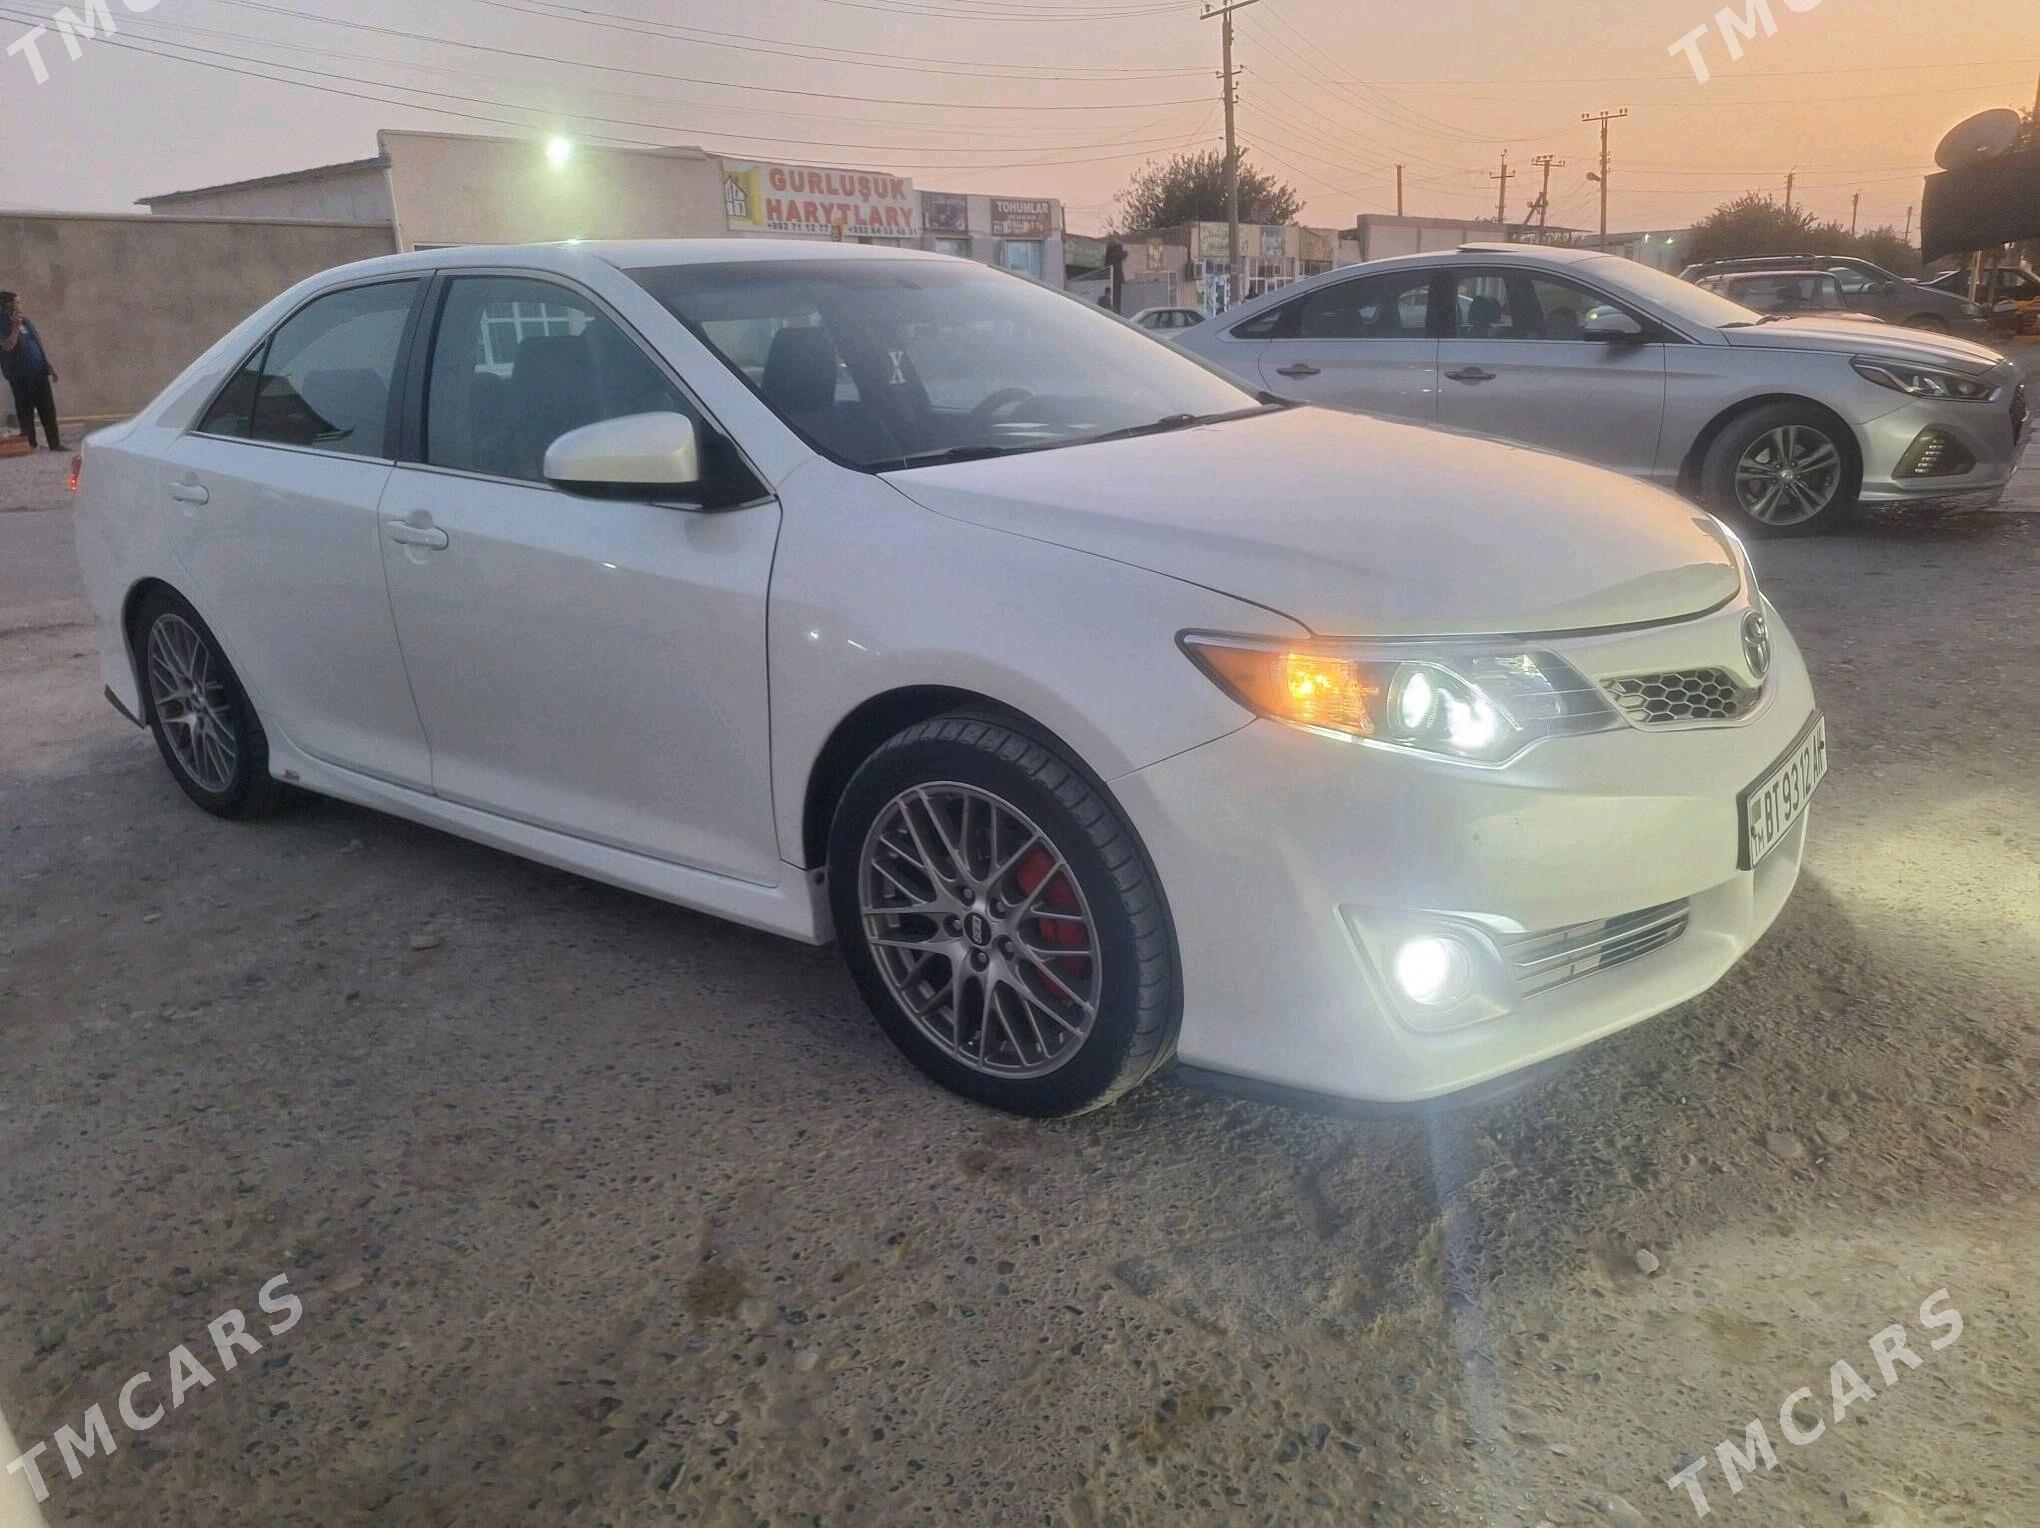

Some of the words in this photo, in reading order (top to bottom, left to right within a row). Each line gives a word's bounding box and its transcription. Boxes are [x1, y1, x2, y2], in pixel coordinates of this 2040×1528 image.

[769, 168, 906, 201] GURLUŞUK
[766, 198, 913, 227] HARYTLARY
[996, 201, 1049, 214] TOHUMLAR
